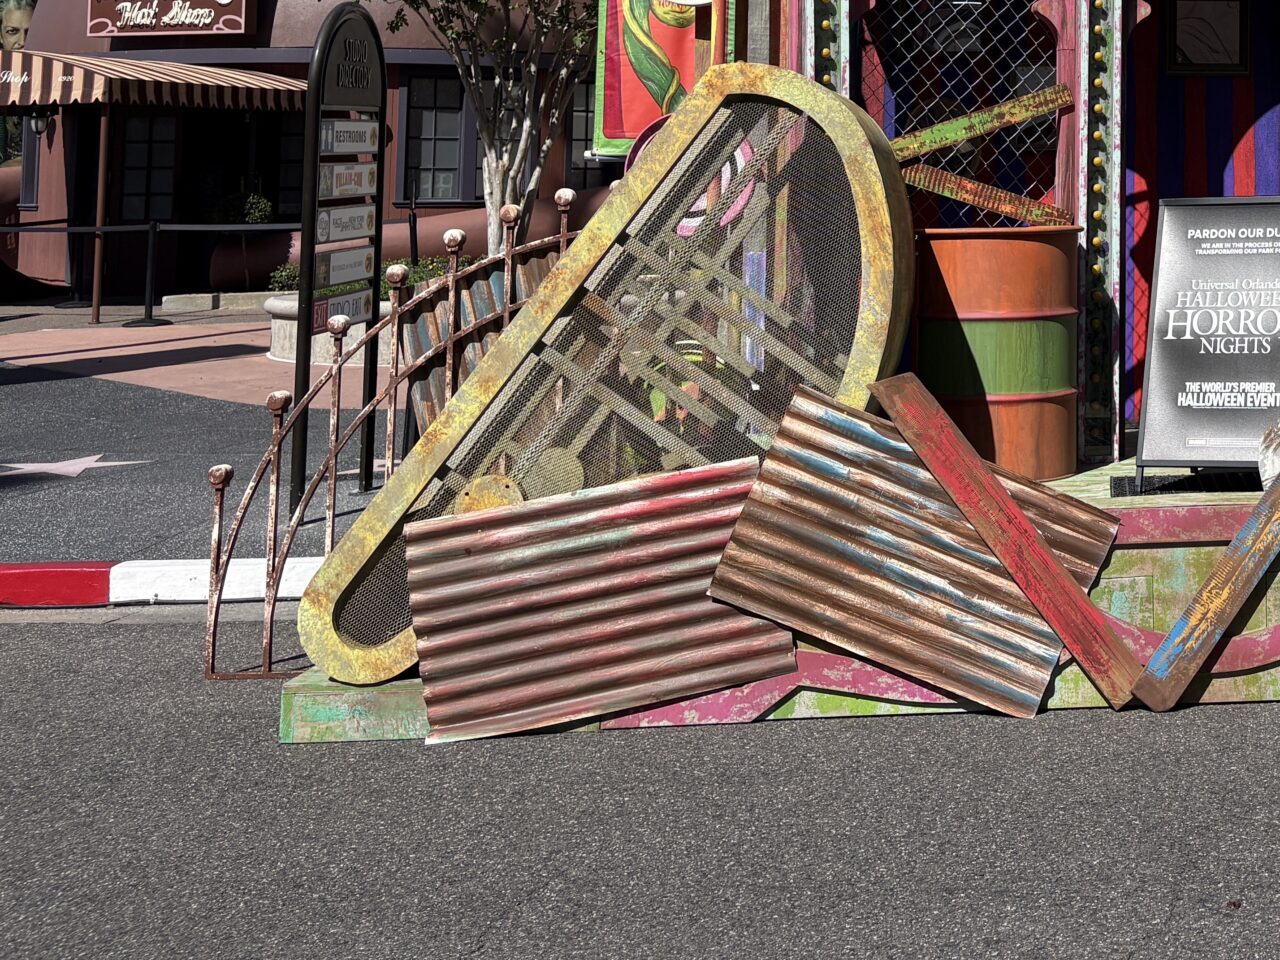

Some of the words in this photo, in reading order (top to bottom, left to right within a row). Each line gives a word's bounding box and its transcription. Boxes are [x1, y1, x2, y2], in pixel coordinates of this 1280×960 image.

[116, 0, 158, 27] Hat
[160, 0, 214, 27] Shop
[344, 38, 368, 63] STUDIO
[337, 64, 372, 88] DIRECTORY
[336, 130, 367, 143] RESTROOMS
[1187, 229, 1236, 239] PARDON
[1239, 228, 1264, 238] OUR
[1191, 279, 1238, 290] Universal
[314, 303, 327, 328] EXIT
[1199, 337, 1271, 354] NIGHTS
[1185, 382, 1201, 392] THE
[1202, 382, 1239, 392] WORLD'S
[1240, 382, 1276, 392] PREMIER
[1177, 392, 1245, 406] HALLOWEEN
